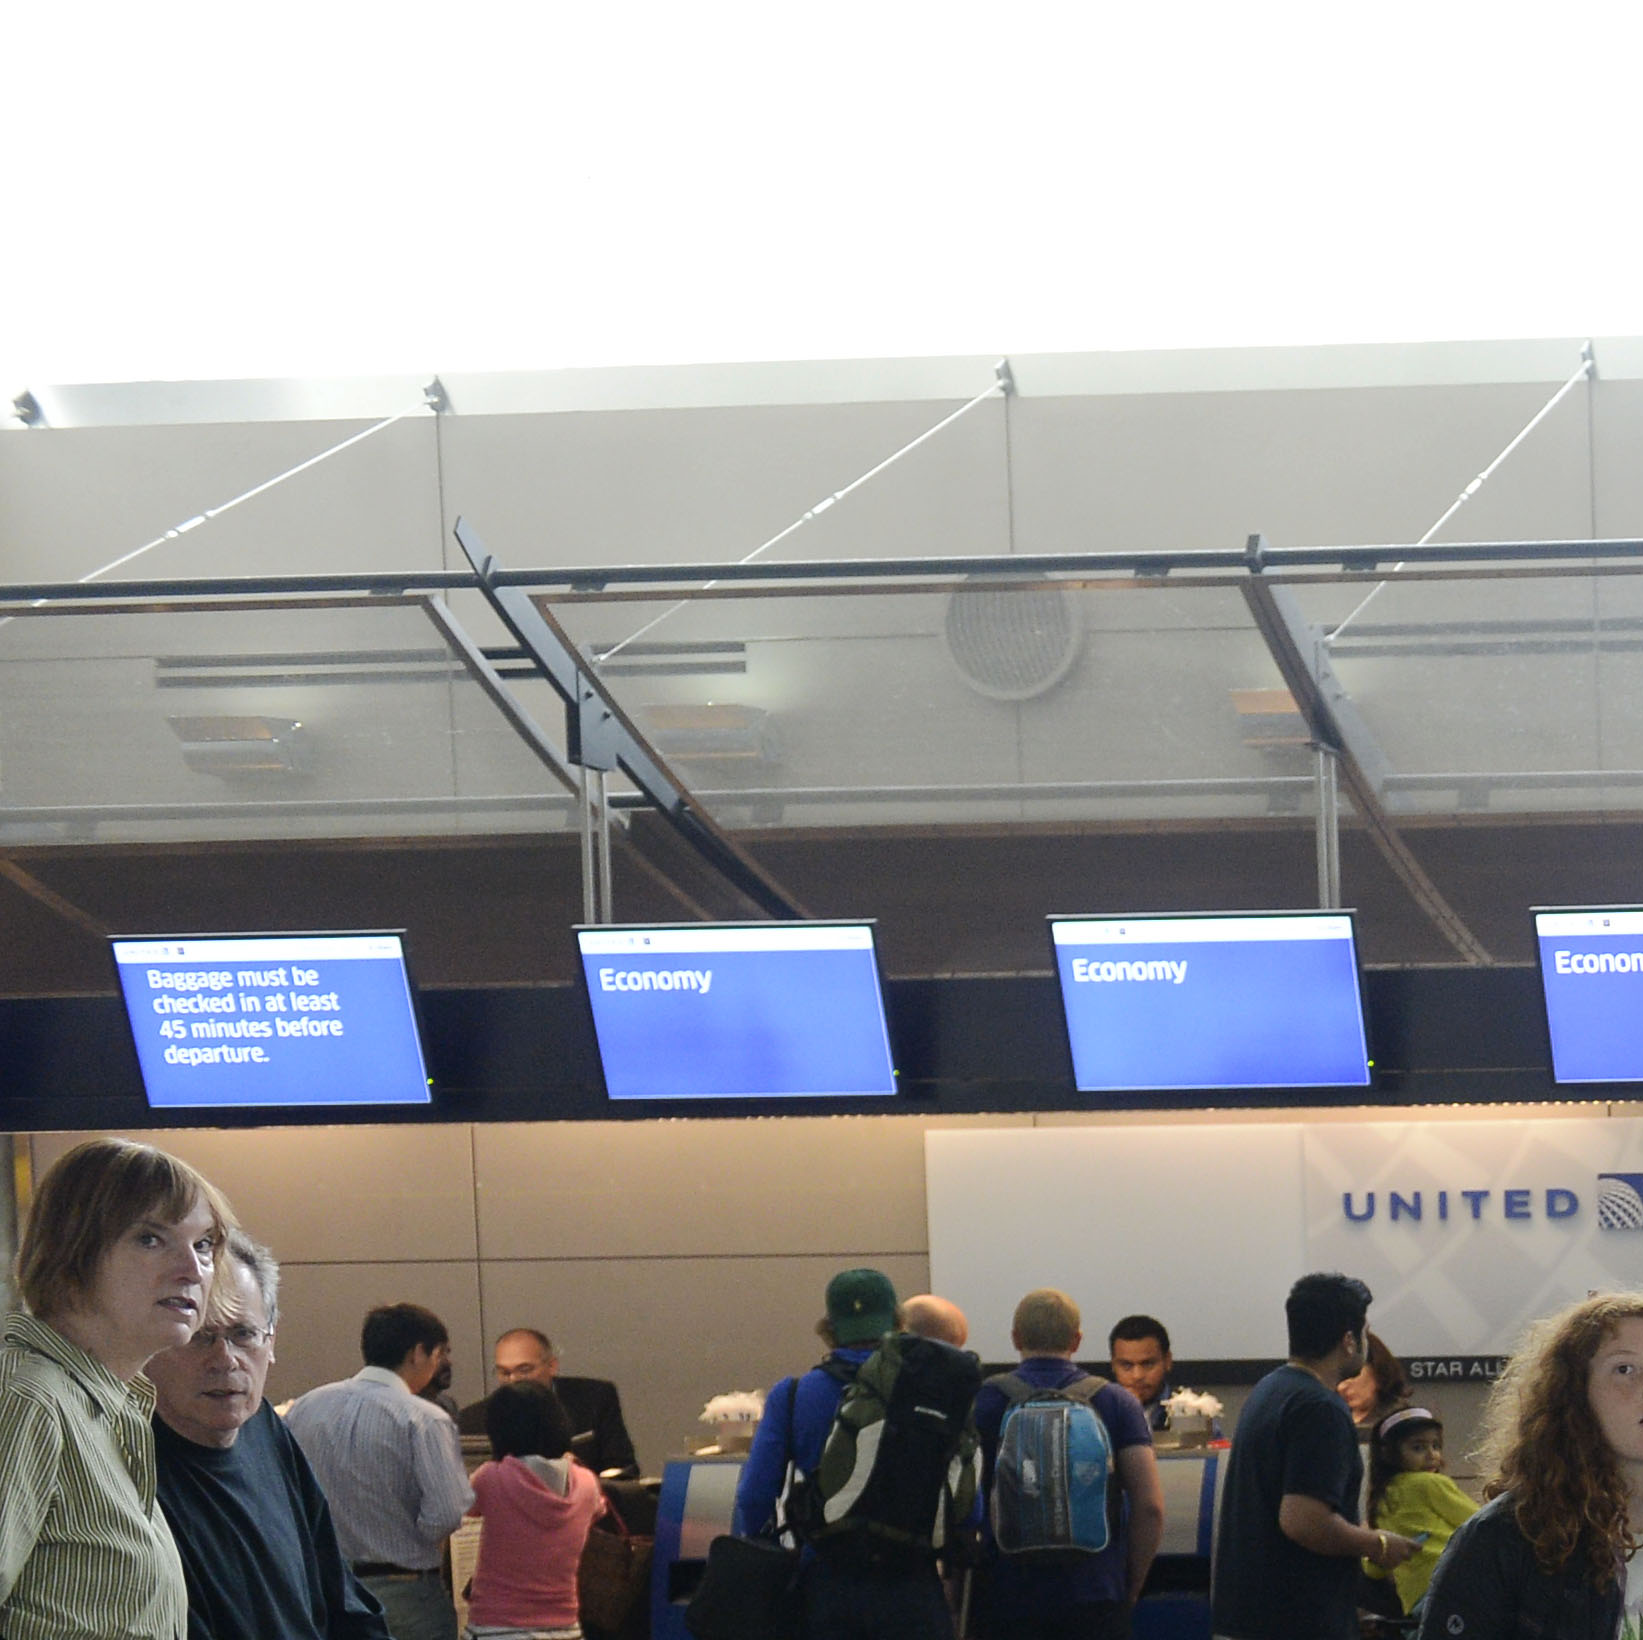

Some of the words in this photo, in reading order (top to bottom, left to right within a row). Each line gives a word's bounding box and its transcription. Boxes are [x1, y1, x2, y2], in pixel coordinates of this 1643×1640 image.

[146, 968, 233, 991] Baggage
[237, 968, 289, 988] must
[291, 966, 320, 987] be
[599, 968, 713, 994] Economy
[1071, 958, 1188, 985] Economy
[153, 994, 236, 1014] checked
[239, 993, 261, 1013] in
[265, 993, 287, 1012] at
[291, 991, 340, 1011] least
[159, 1019, 187, 1039] 45
[190, 1018, 273, 1038] minutes
[275, 1016, 344, 1037] before
[163, 1045, 271, 1067] departure.
[1342, 1188, 1580, 1223] UNITED
[1410, 1361, 1464, 1378] STAR
